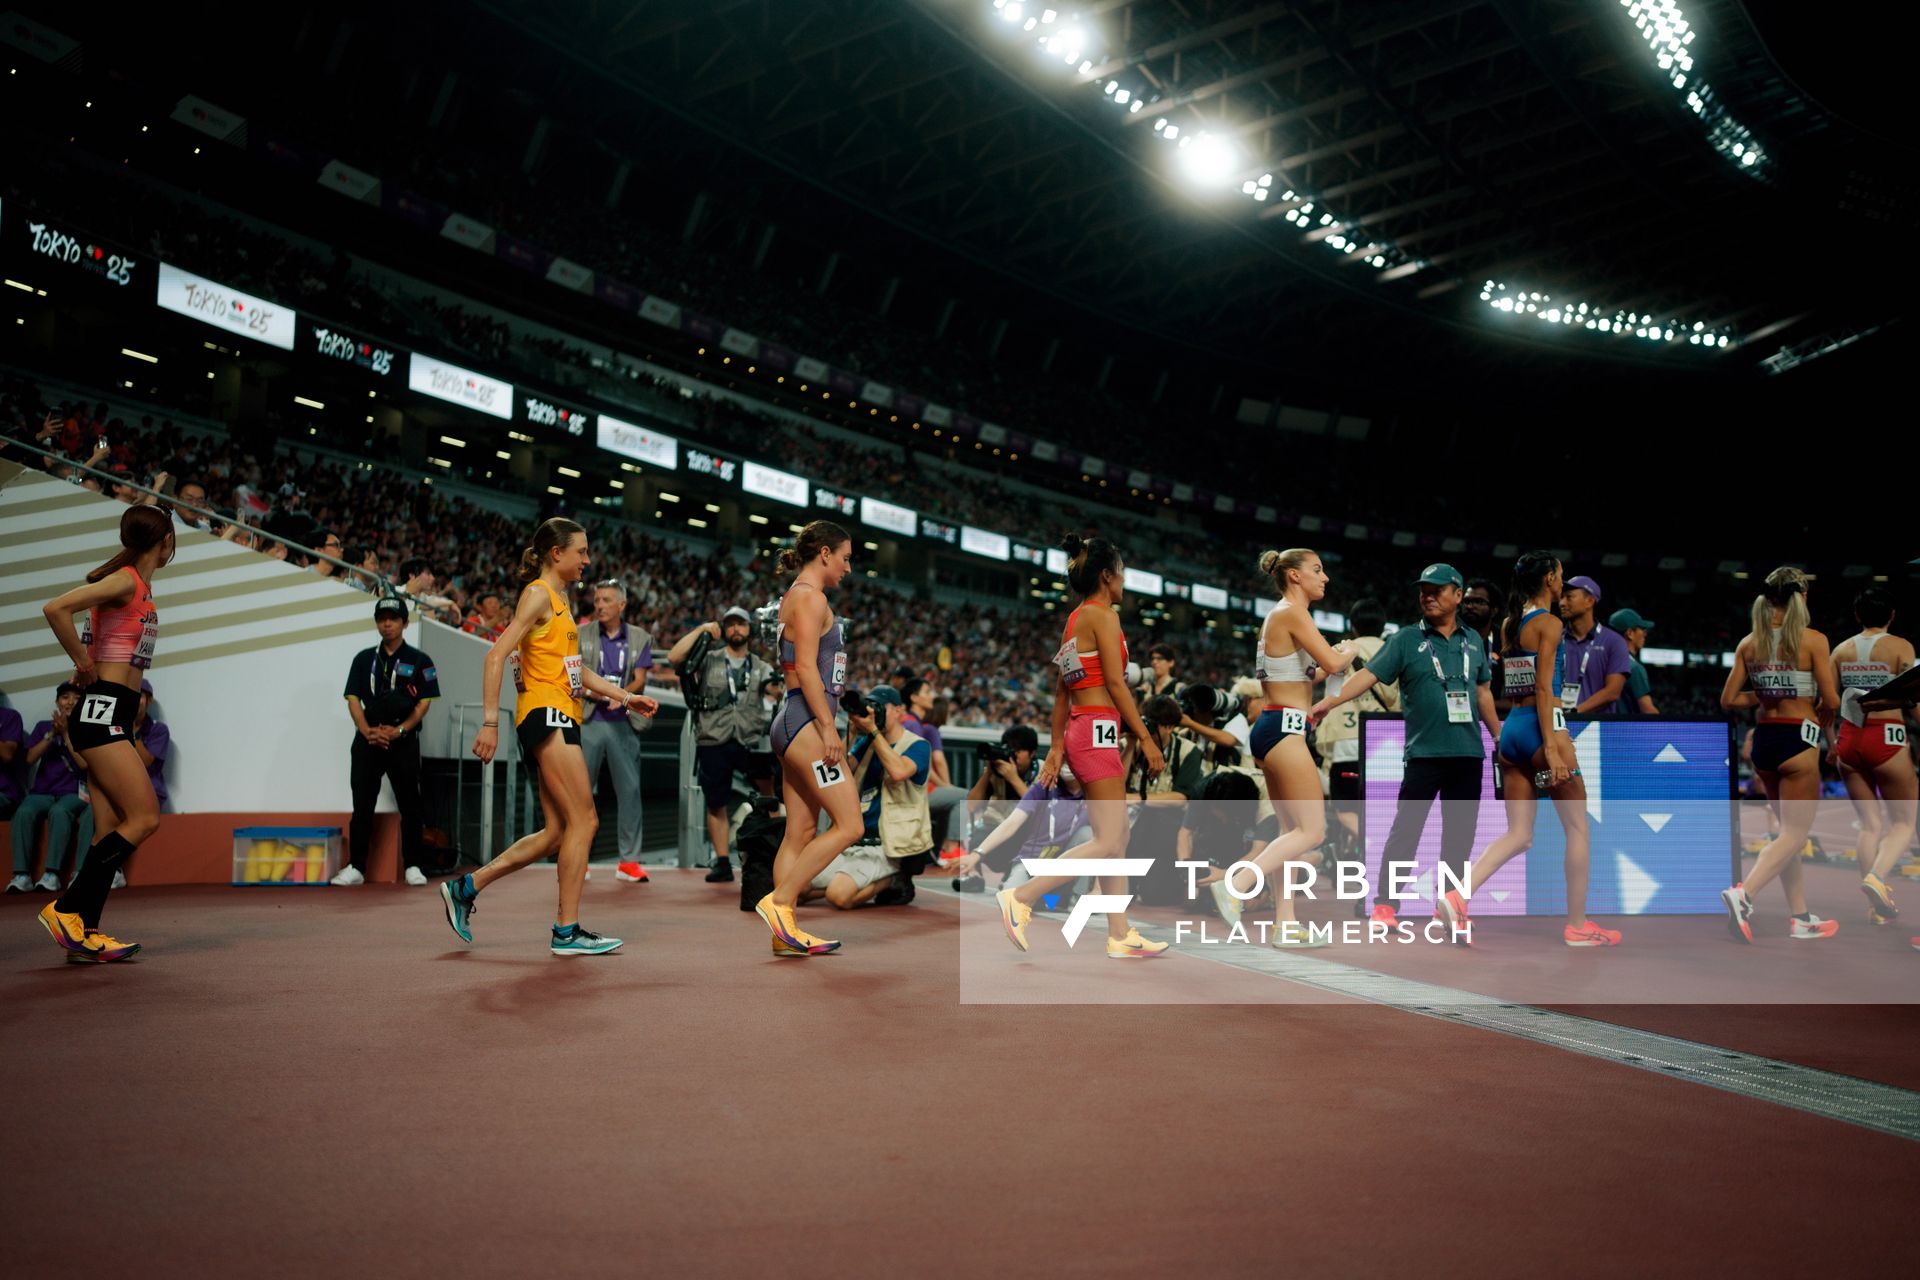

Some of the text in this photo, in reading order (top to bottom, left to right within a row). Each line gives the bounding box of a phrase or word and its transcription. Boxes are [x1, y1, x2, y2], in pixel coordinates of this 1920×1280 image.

[29, 221, 82, 264] TOKYO
[106, 254, 137, 286] 25
[184, 283, 227, 317] TOKYO
[248, 308, 272, 333] 25
[314, 327, 355, 361] TOKYO
[371, 348, 394, 376] 25
[87, 699, 112, 720] 17
[1286, 712, 1303, 731] 13
[1343, 712, 1356, 728] 3
[1095, 725, 1116, 744] 14
[1805, 724, 1817, 742] 11
[1887, 727, 1905, 743] 10
[816, 764, 840, 783] 15
